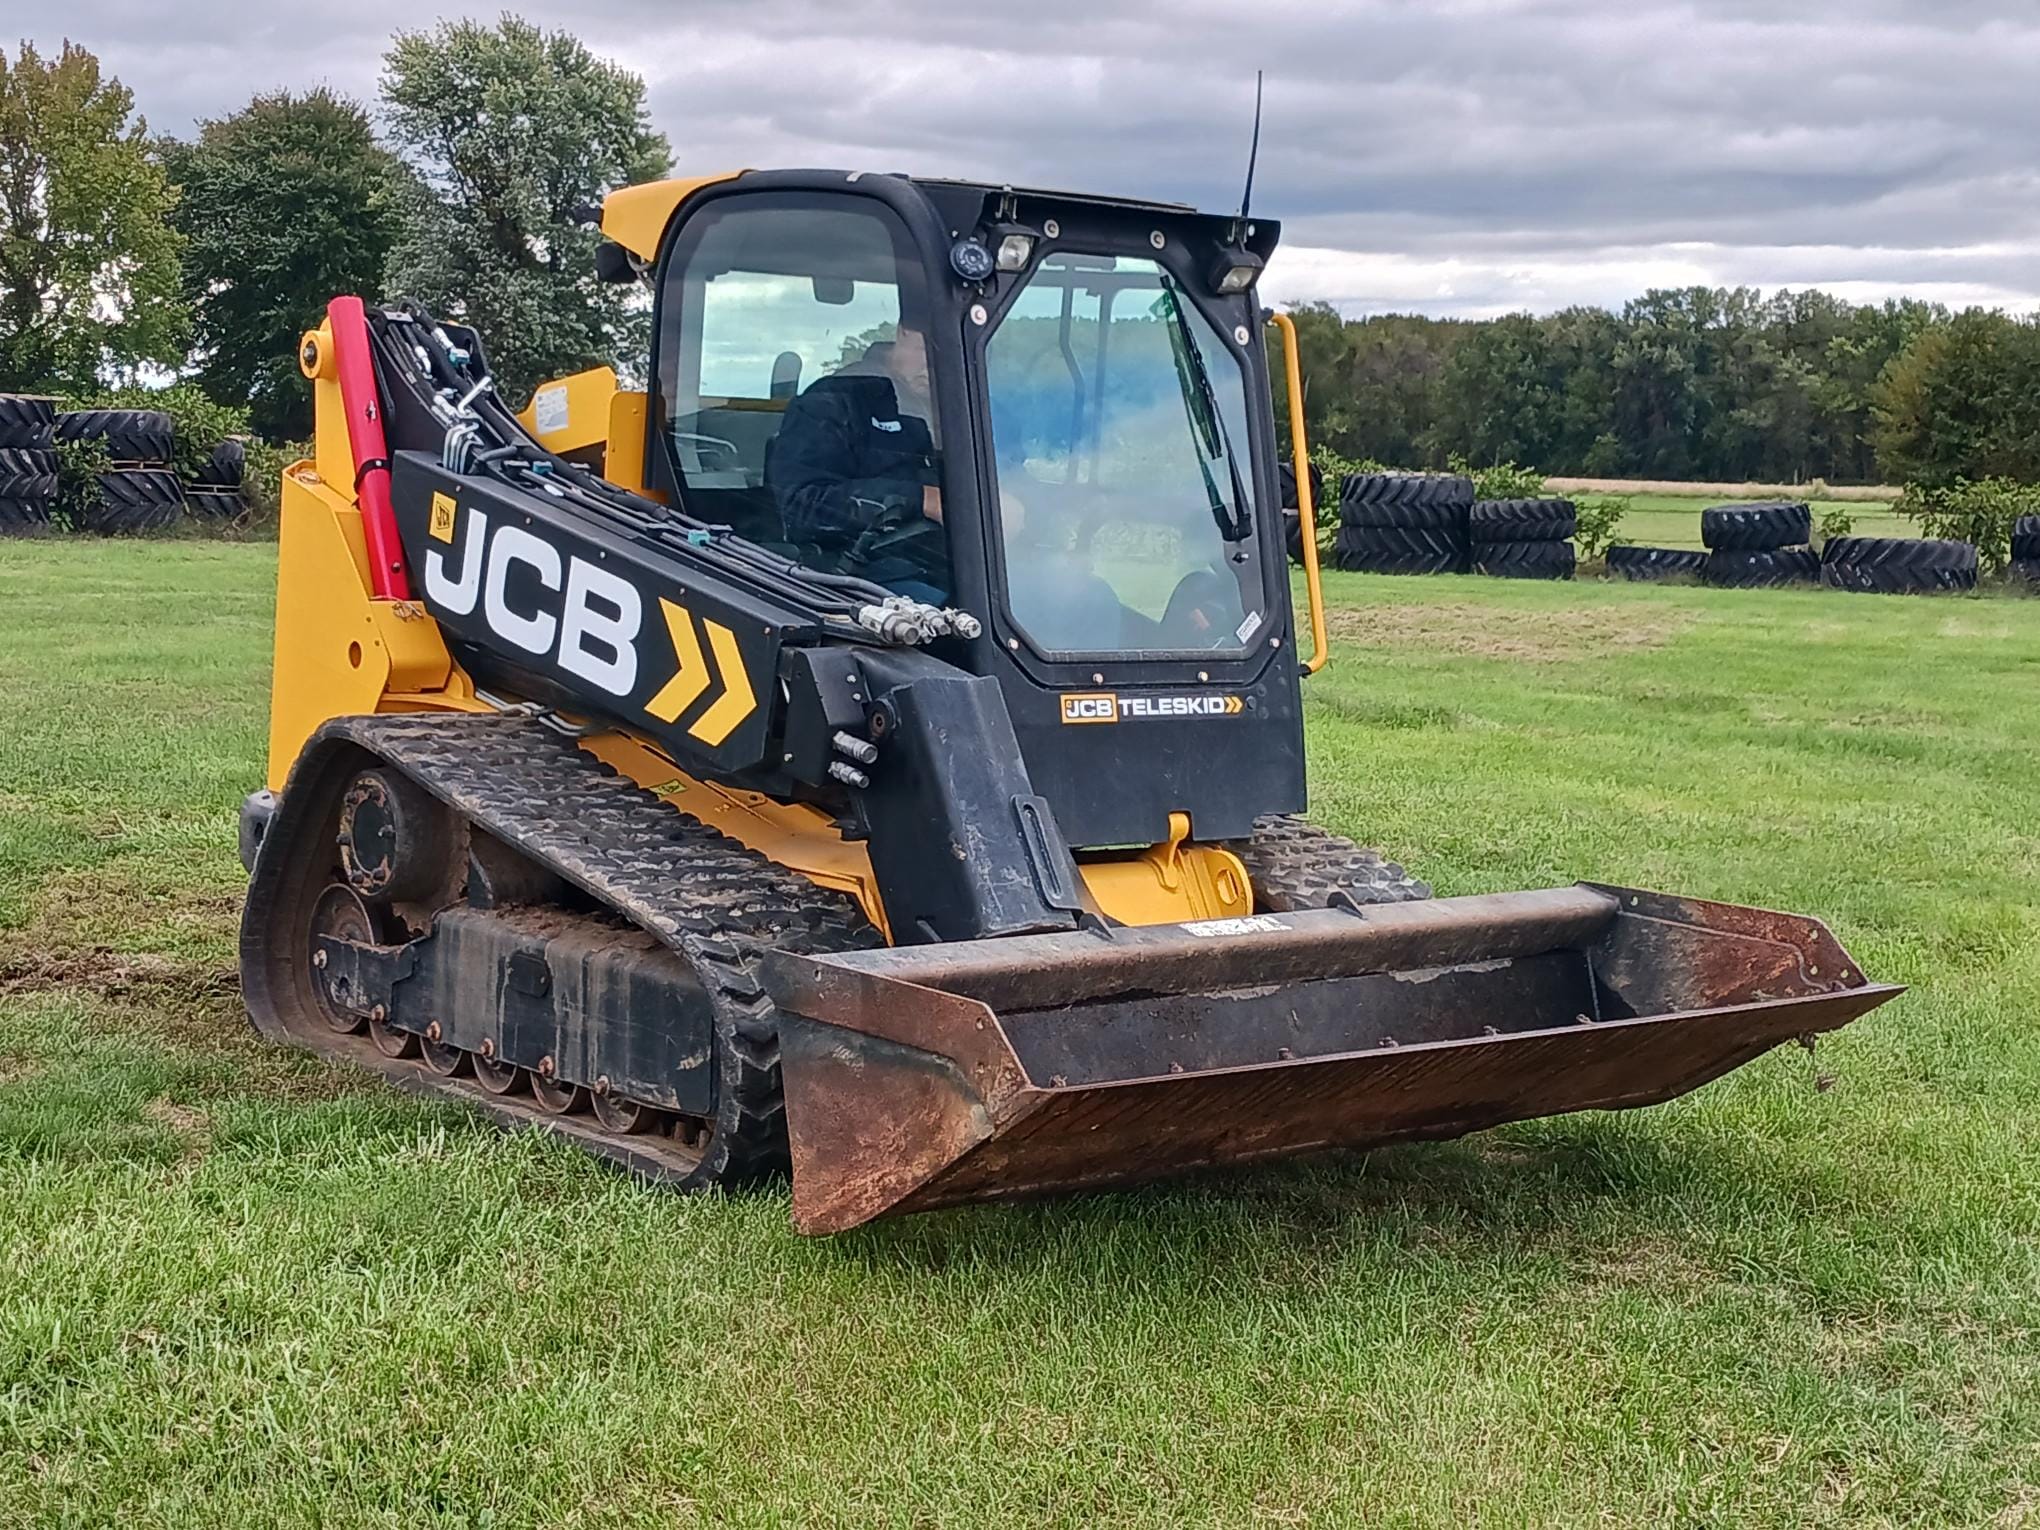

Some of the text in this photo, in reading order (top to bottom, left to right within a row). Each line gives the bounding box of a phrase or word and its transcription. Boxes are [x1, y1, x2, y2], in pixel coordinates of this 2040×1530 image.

[425, 507, 642, 696] JCB
[1066, 697, 1225, 717] JCB TELESKID
